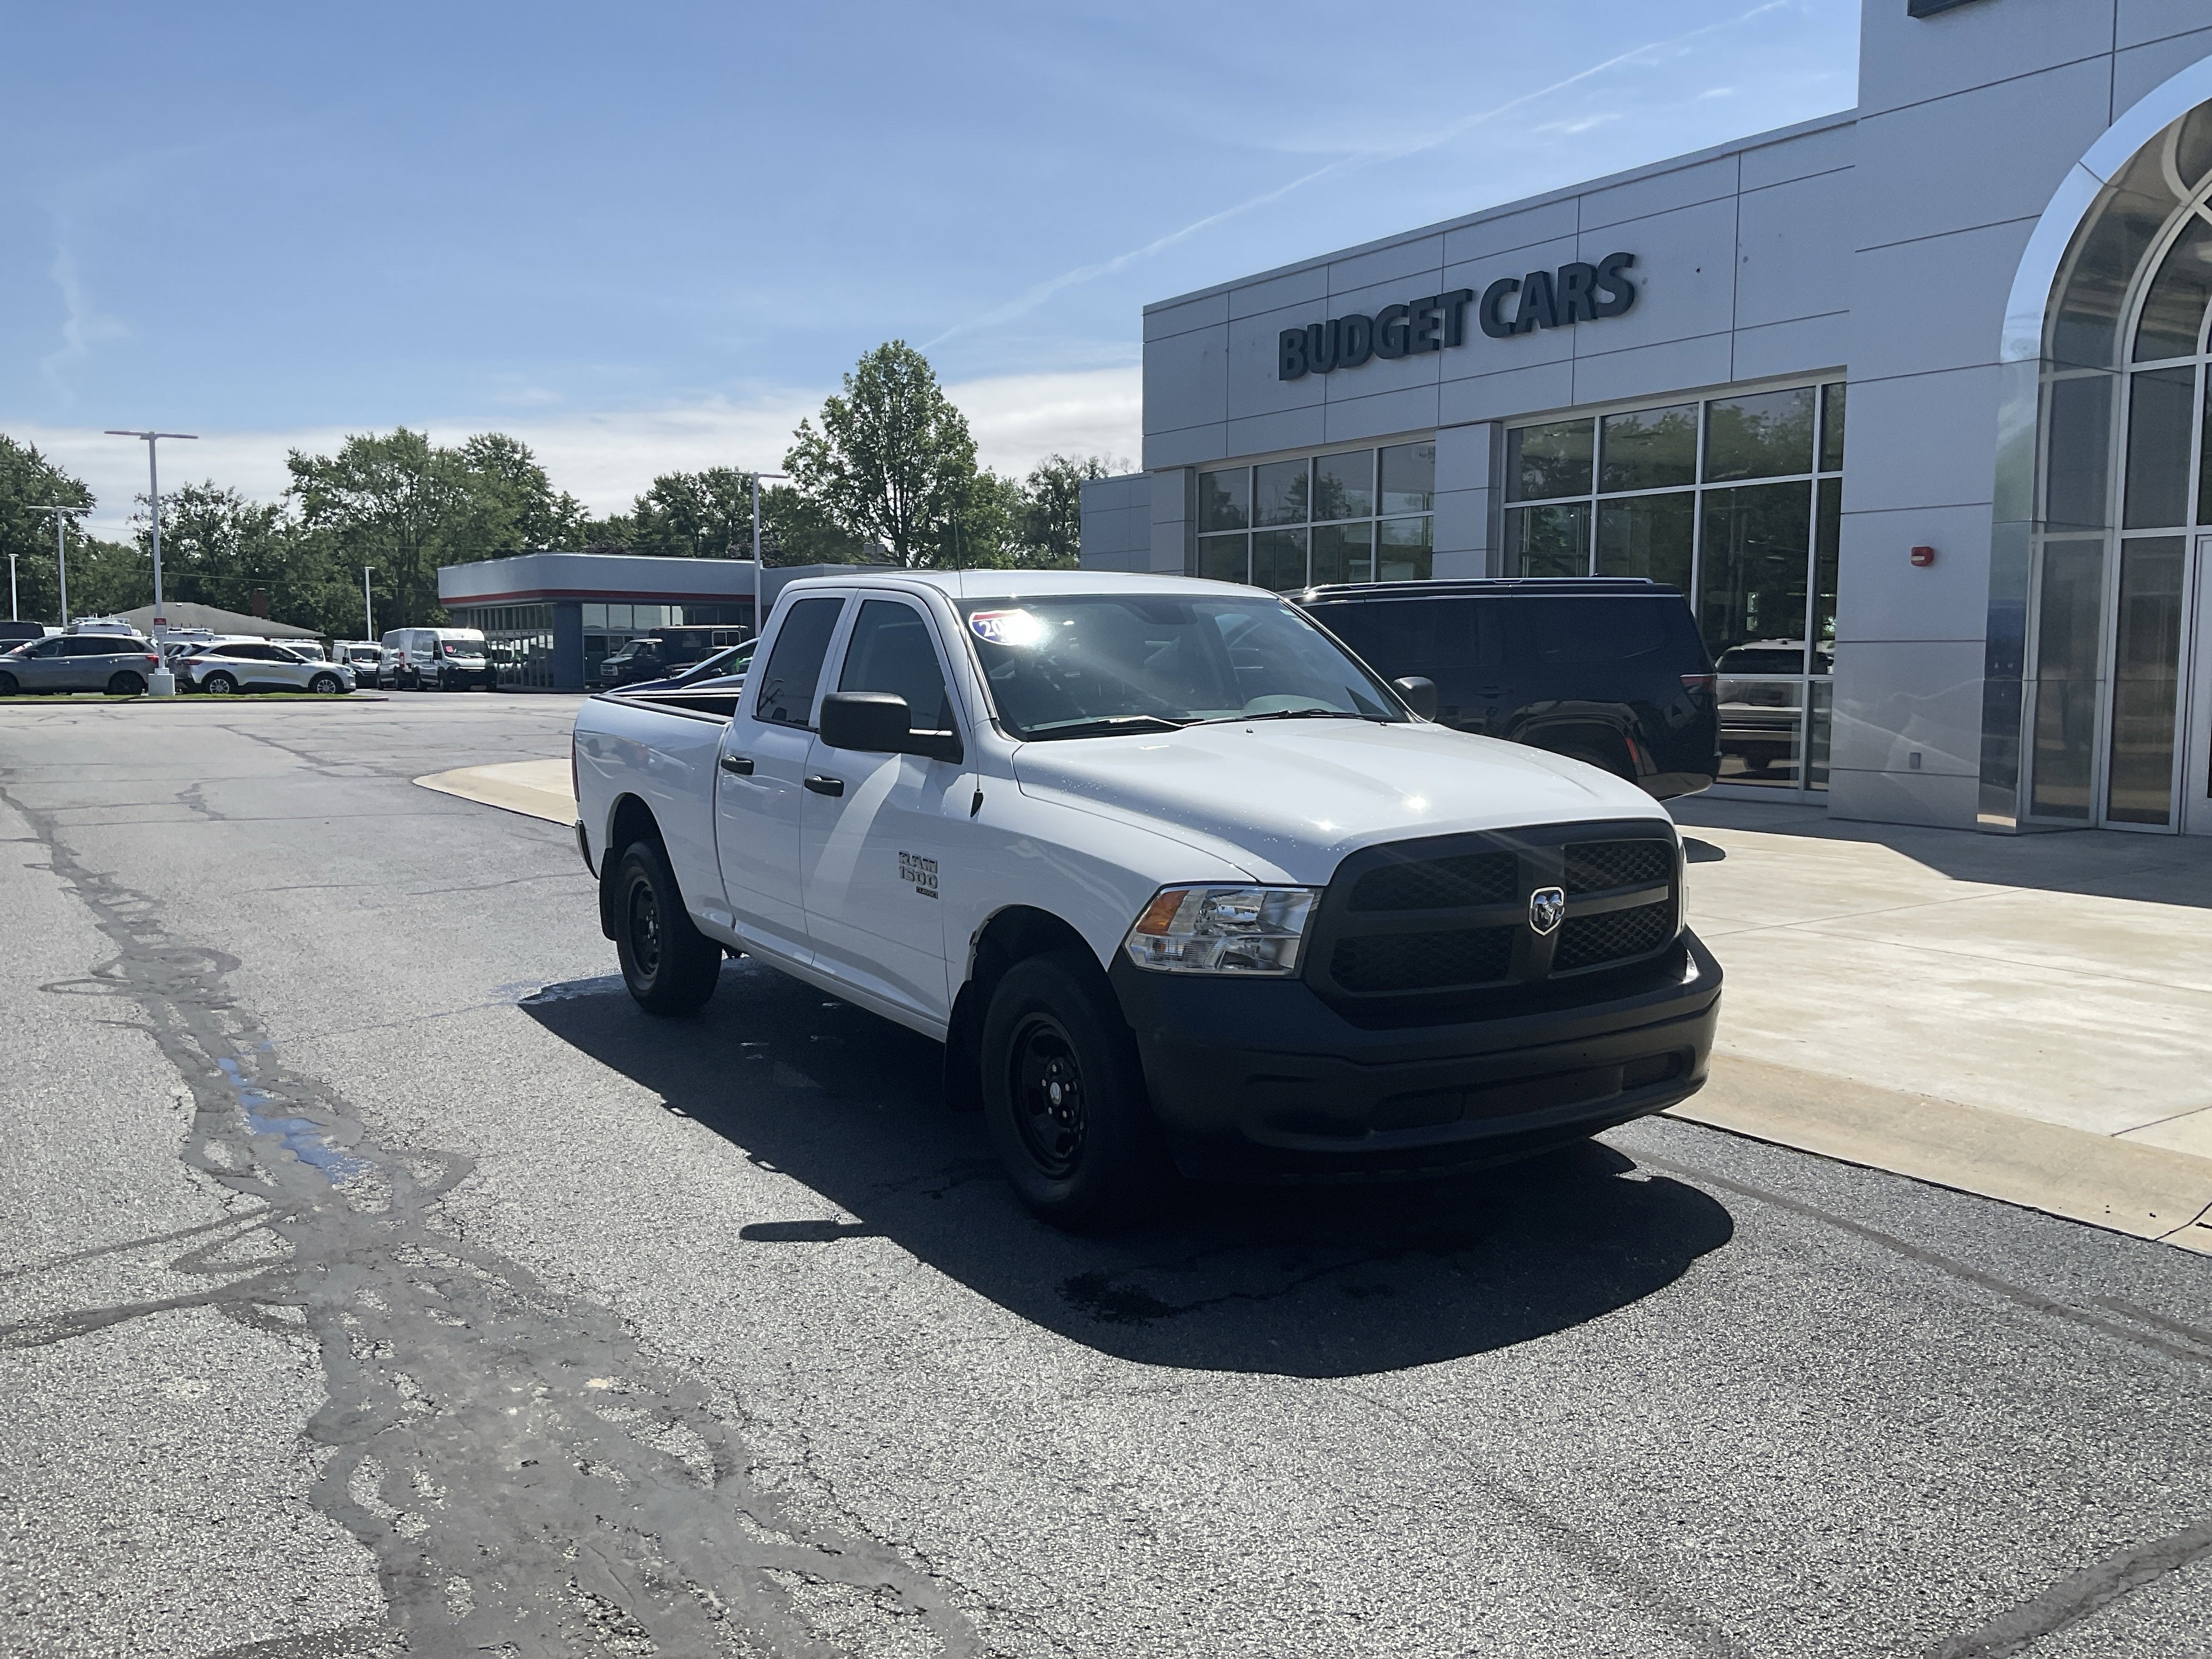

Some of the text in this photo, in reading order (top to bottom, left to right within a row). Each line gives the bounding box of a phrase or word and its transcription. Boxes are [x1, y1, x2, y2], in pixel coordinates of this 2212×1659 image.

[1279, 252, 1636, 381] BUDGET CARS
[899, 850, 938, 874] RAM
[899, 865, 938, 889] 1500
